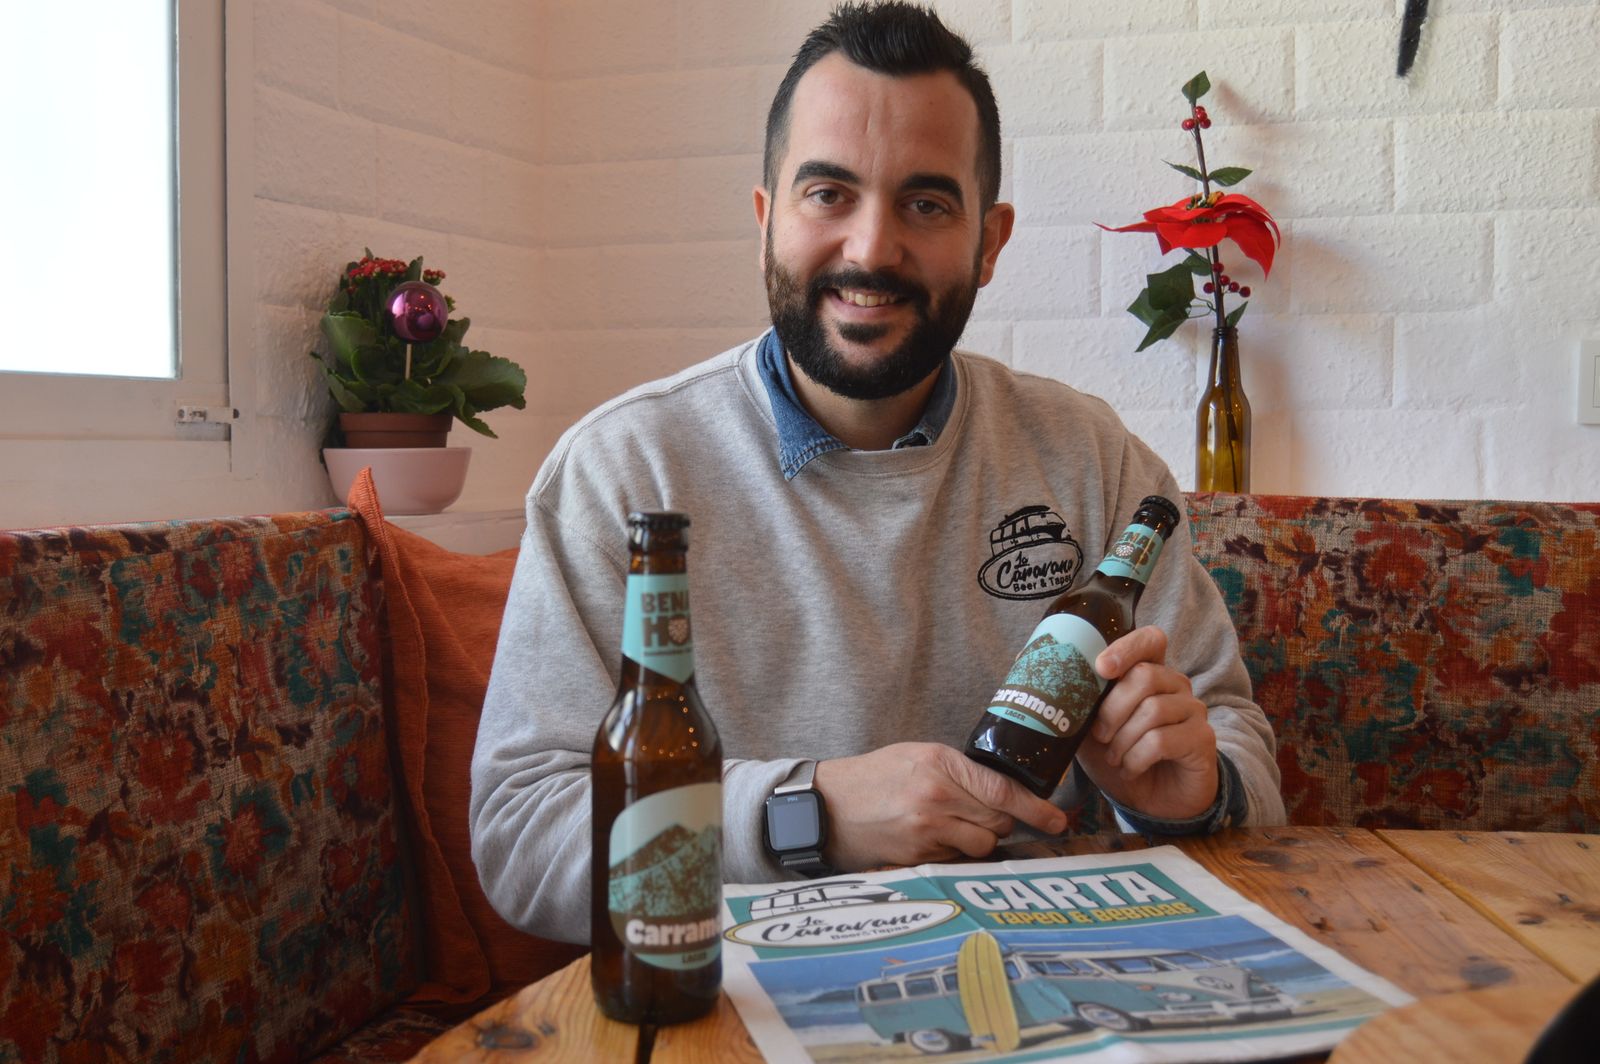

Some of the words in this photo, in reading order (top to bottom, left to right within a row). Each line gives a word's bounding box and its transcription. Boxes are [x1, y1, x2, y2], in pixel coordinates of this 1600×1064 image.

[997, 559, 1073, 589] Caravana
[1013, 582, 1037, 592] Beer
[1040, 578, 1047, 588] &
[1049, 575, 1072, 587] Tapas
[990, 688, 1070, 733] arramolo
[954, 871, 1179, 911] CARTA
[625, 918, 720, 946] Carram
[762, 911, 932, 942] Caravana
[1069, 910, 1094, 924] &
